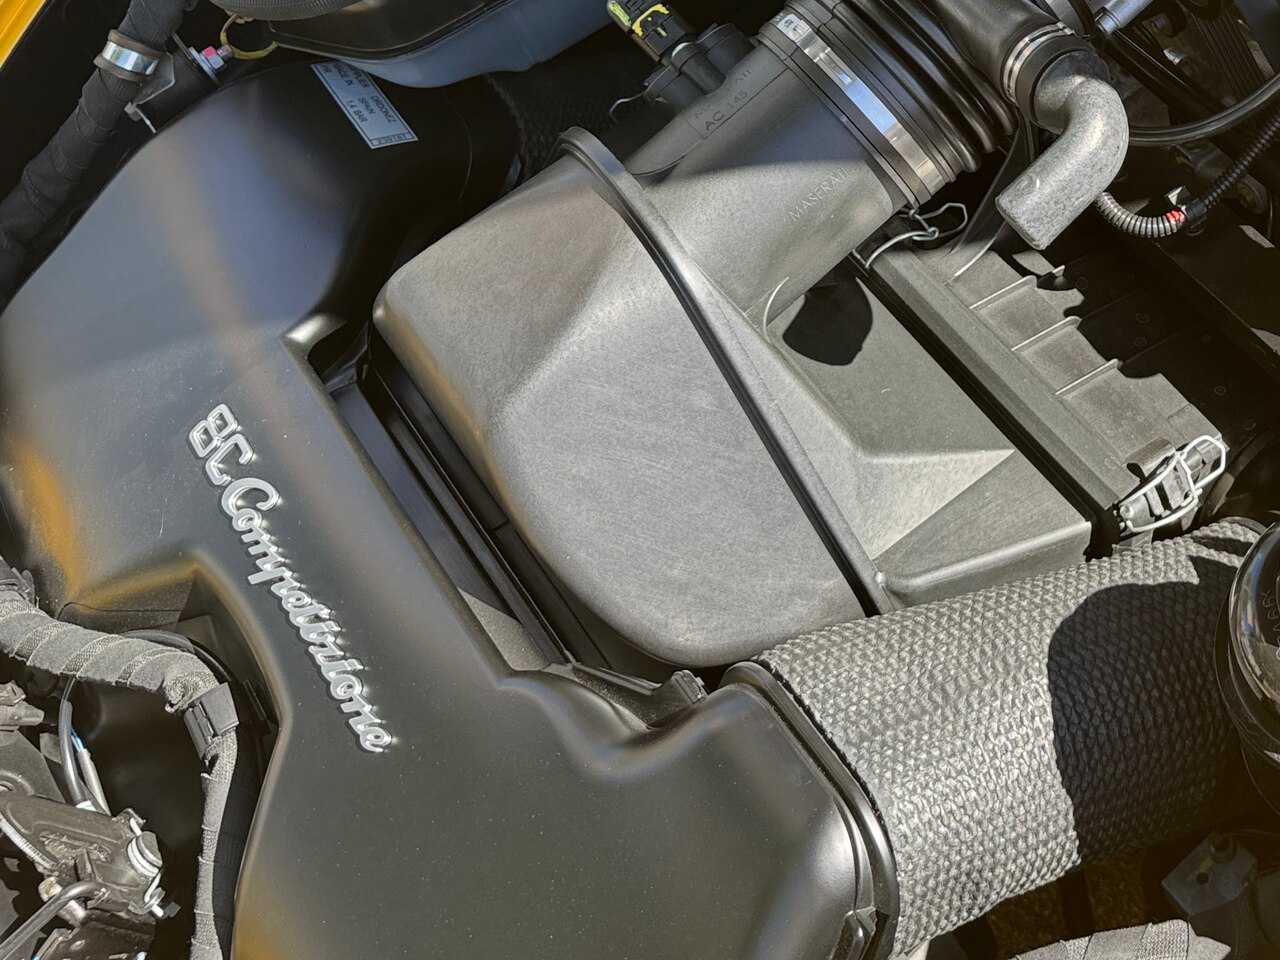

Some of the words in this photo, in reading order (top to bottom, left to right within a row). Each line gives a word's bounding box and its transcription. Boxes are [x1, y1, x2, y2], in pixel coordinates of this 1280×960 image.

[787, 166, 850, 223] MASERATI
[189, 402, 256, 487] 8C
[221, 476, 394, 754] Competizione
